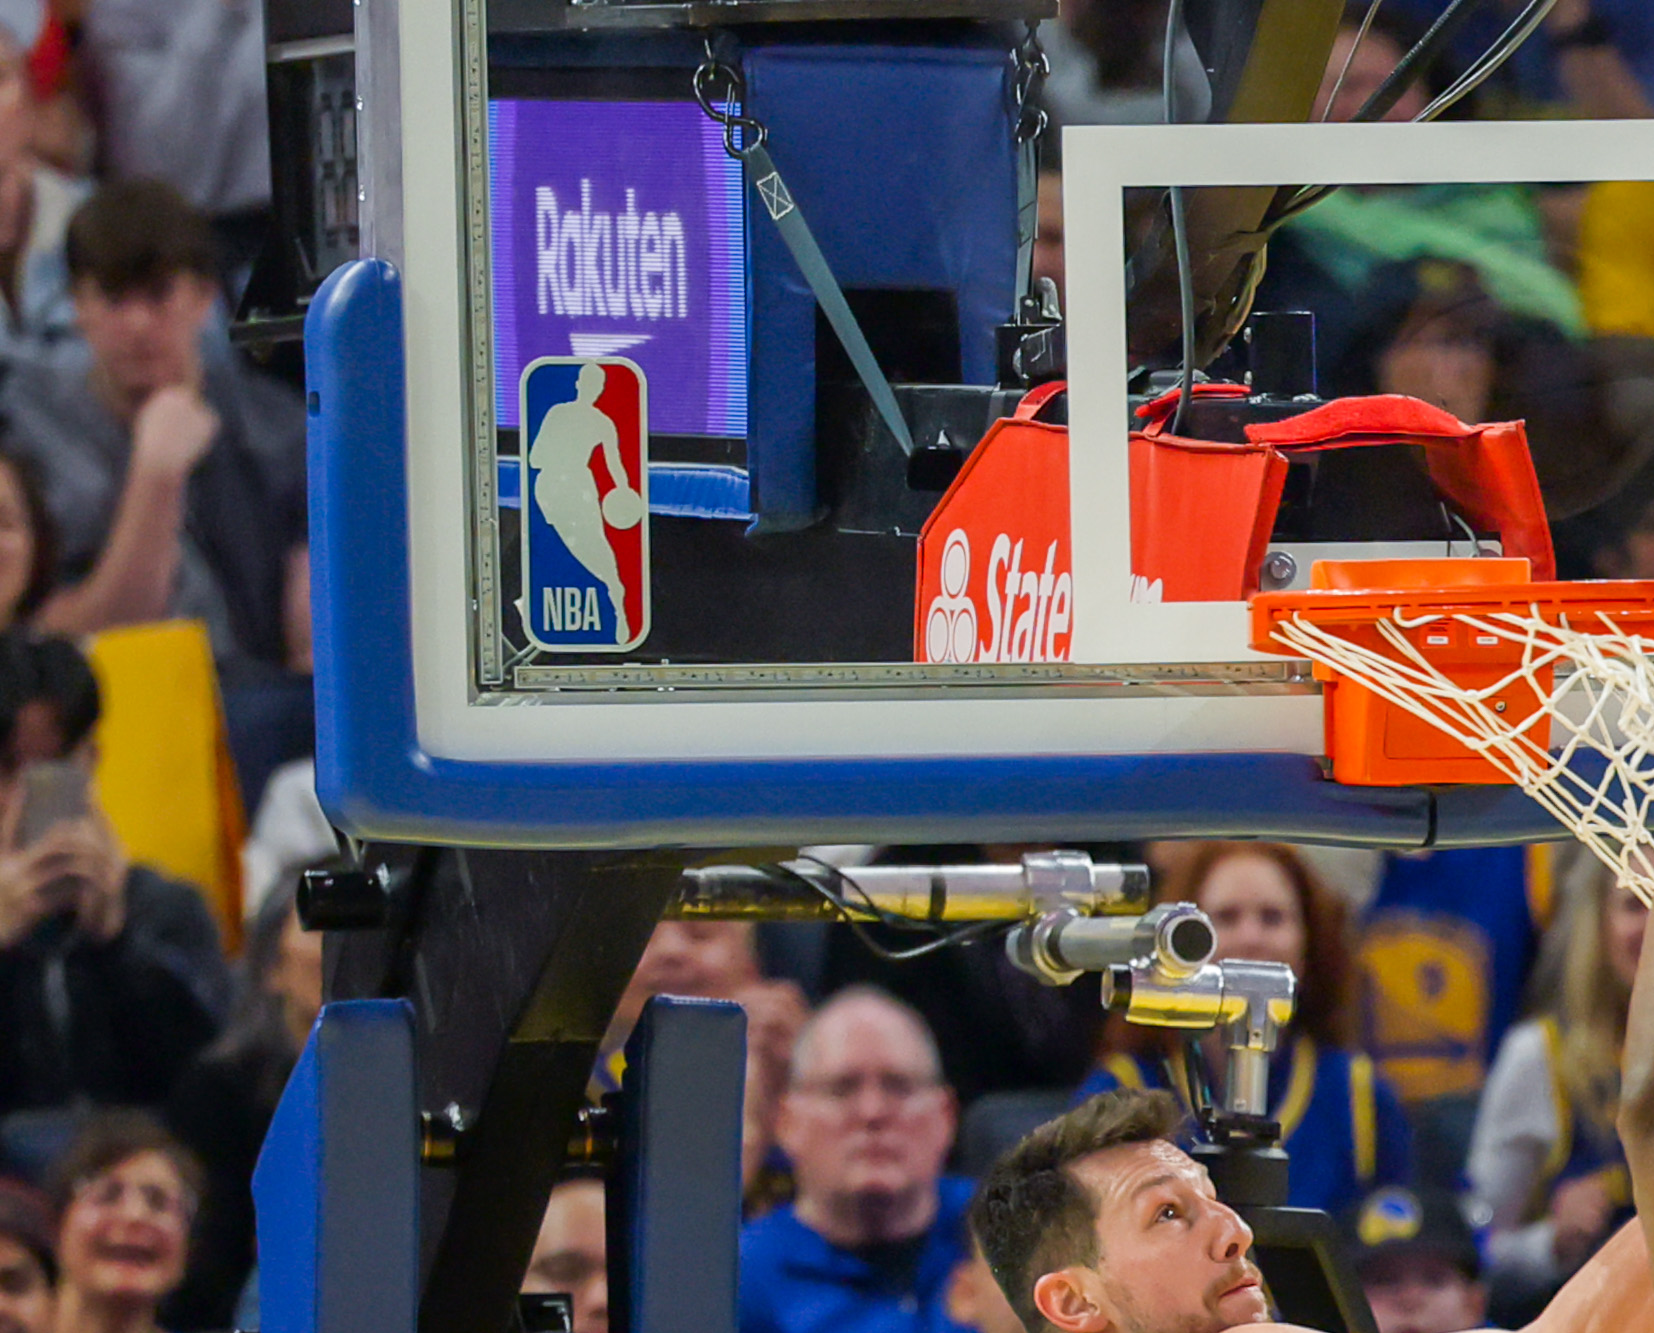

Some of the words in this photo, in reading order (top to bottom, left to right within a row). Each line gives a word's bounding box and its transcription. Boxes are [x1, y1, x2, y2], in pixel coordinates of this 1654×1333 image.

[535, 178, 688, 319] Rakuten
[542, 586, 602, 632] NBA
[979, 532, 1073, 662] State
